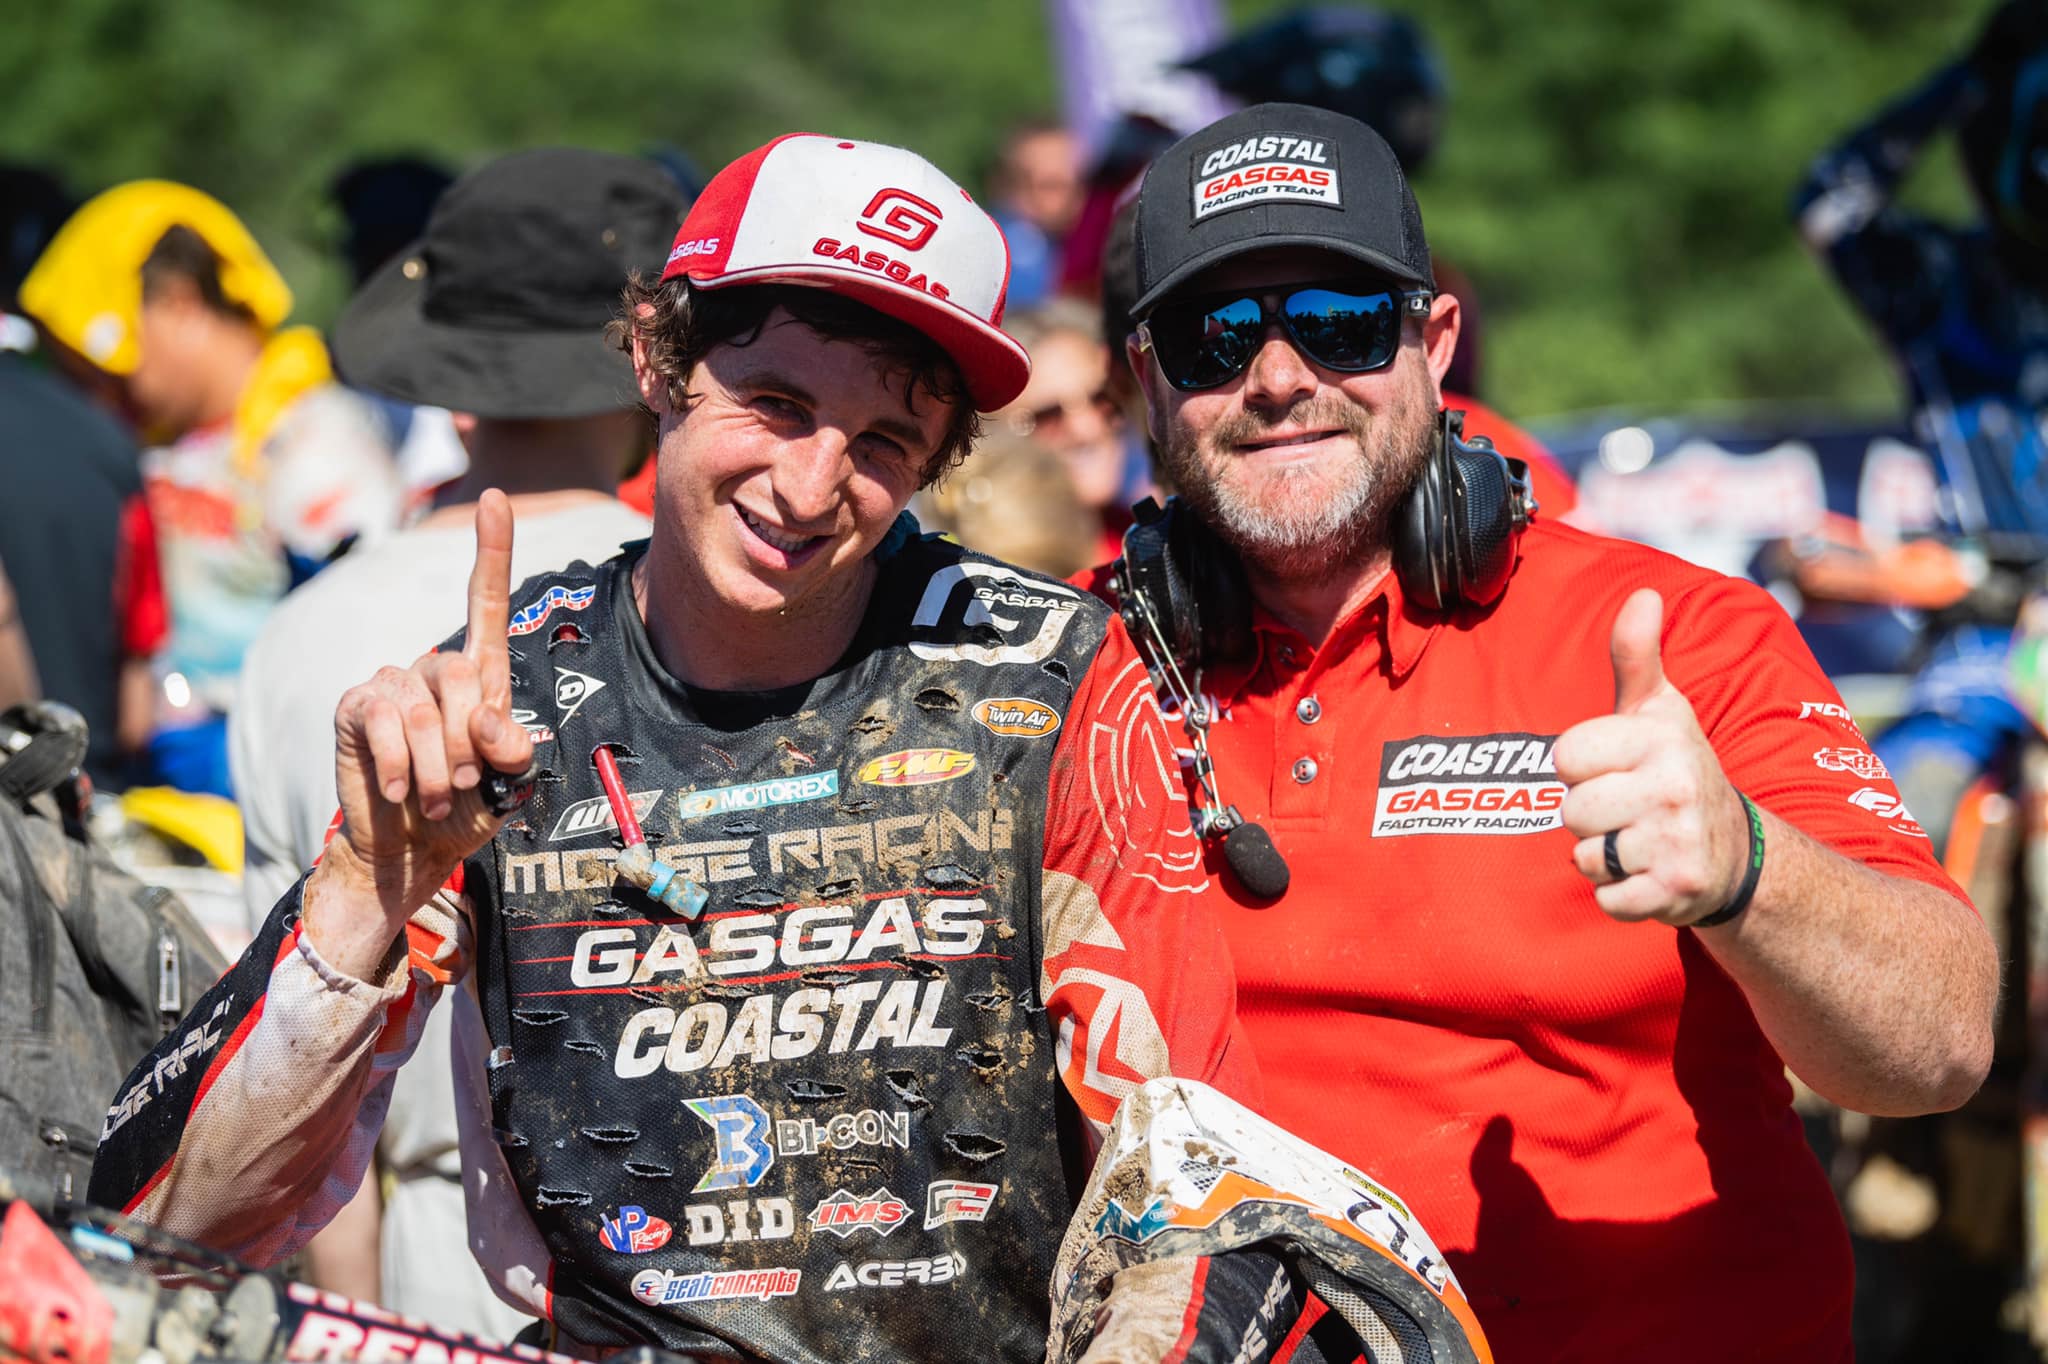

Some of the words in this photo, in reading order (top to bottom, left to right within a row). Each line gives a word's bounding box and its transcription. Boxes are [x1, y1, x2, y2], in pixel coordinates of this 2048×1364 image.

[1201, 136, 1327, 176] COASTAL
[1201, 185, 1268, 211] RACING
[1273, 185, 1325, 197] TEAM
[1204, 166, 1330, 199] GASGAS
[812, 237, 950, 300] GASGAS
[509, 585, 597, 626] ARTS
[974, 586, 1079, 612] GASGAS
[987, 704, 1025, 725] Twin
[1023, 710, 1052, 728] Air
[861, 751, 975, 783] FMF
[719, 773, 834, 810] MOTOREX
[1386, 787, 1565, 814] GASGAS
[1378, 816, 1472, 832] FACTORY
[1473, 816, 1555, 829] RACING
[569, 898, 987, 988] GASGAS
[614, 980, 954, 1079] COASTAL
[775, 1109, 910, 1157] BI-CON
[600, 1204, 650, 1254] VP
[633, 1226, 673, 1249] Racing
[817, 1201, 905, 1226] IMS
